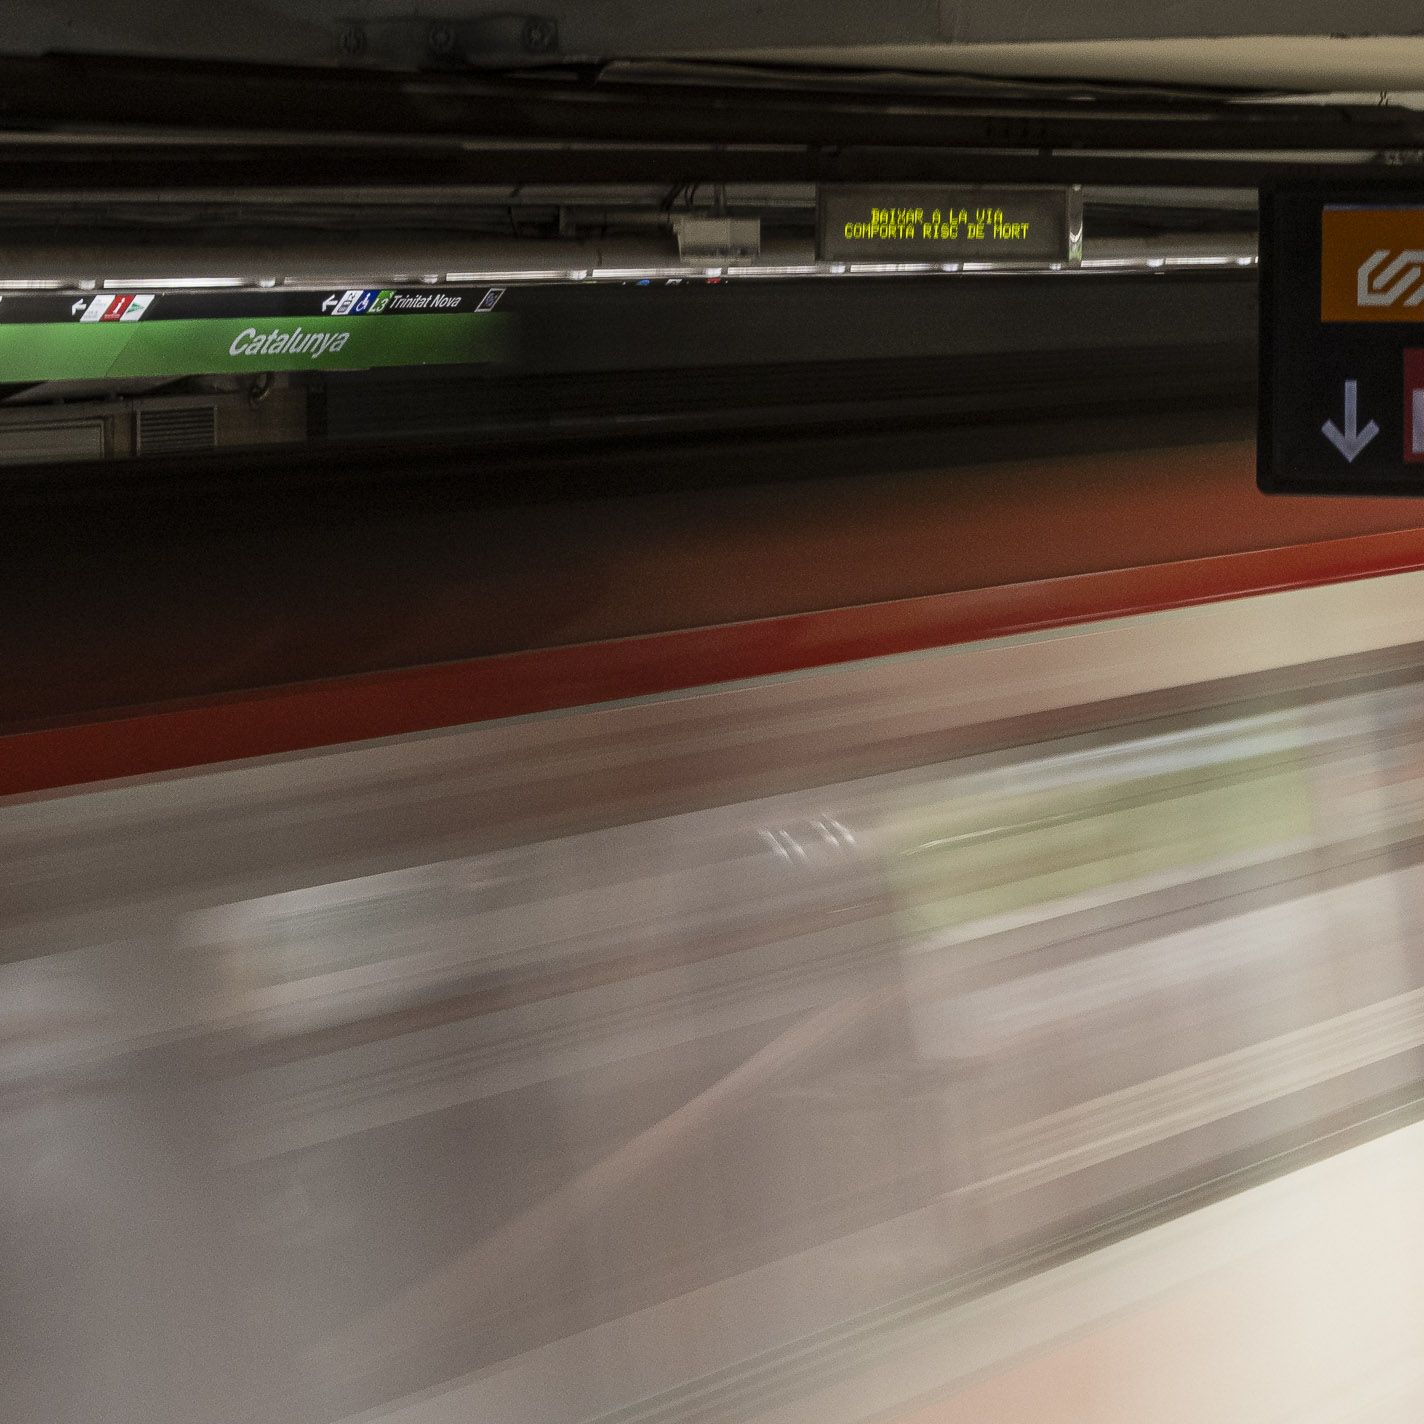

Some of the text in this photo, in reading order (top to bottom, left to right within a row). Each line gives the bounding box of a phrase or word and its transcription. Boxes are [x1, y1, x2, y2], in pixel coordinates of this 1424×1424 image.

[870, 207, 1004, 225] BAIXAR A LA VIA
[843, 222, 1030, 239] COMPORTA RISC DE MORT
[368, 297, 389, 313] L3
[389, 293, 463, 309] Trinitat Nova
[228, 326, 351, 360] Catalunya
